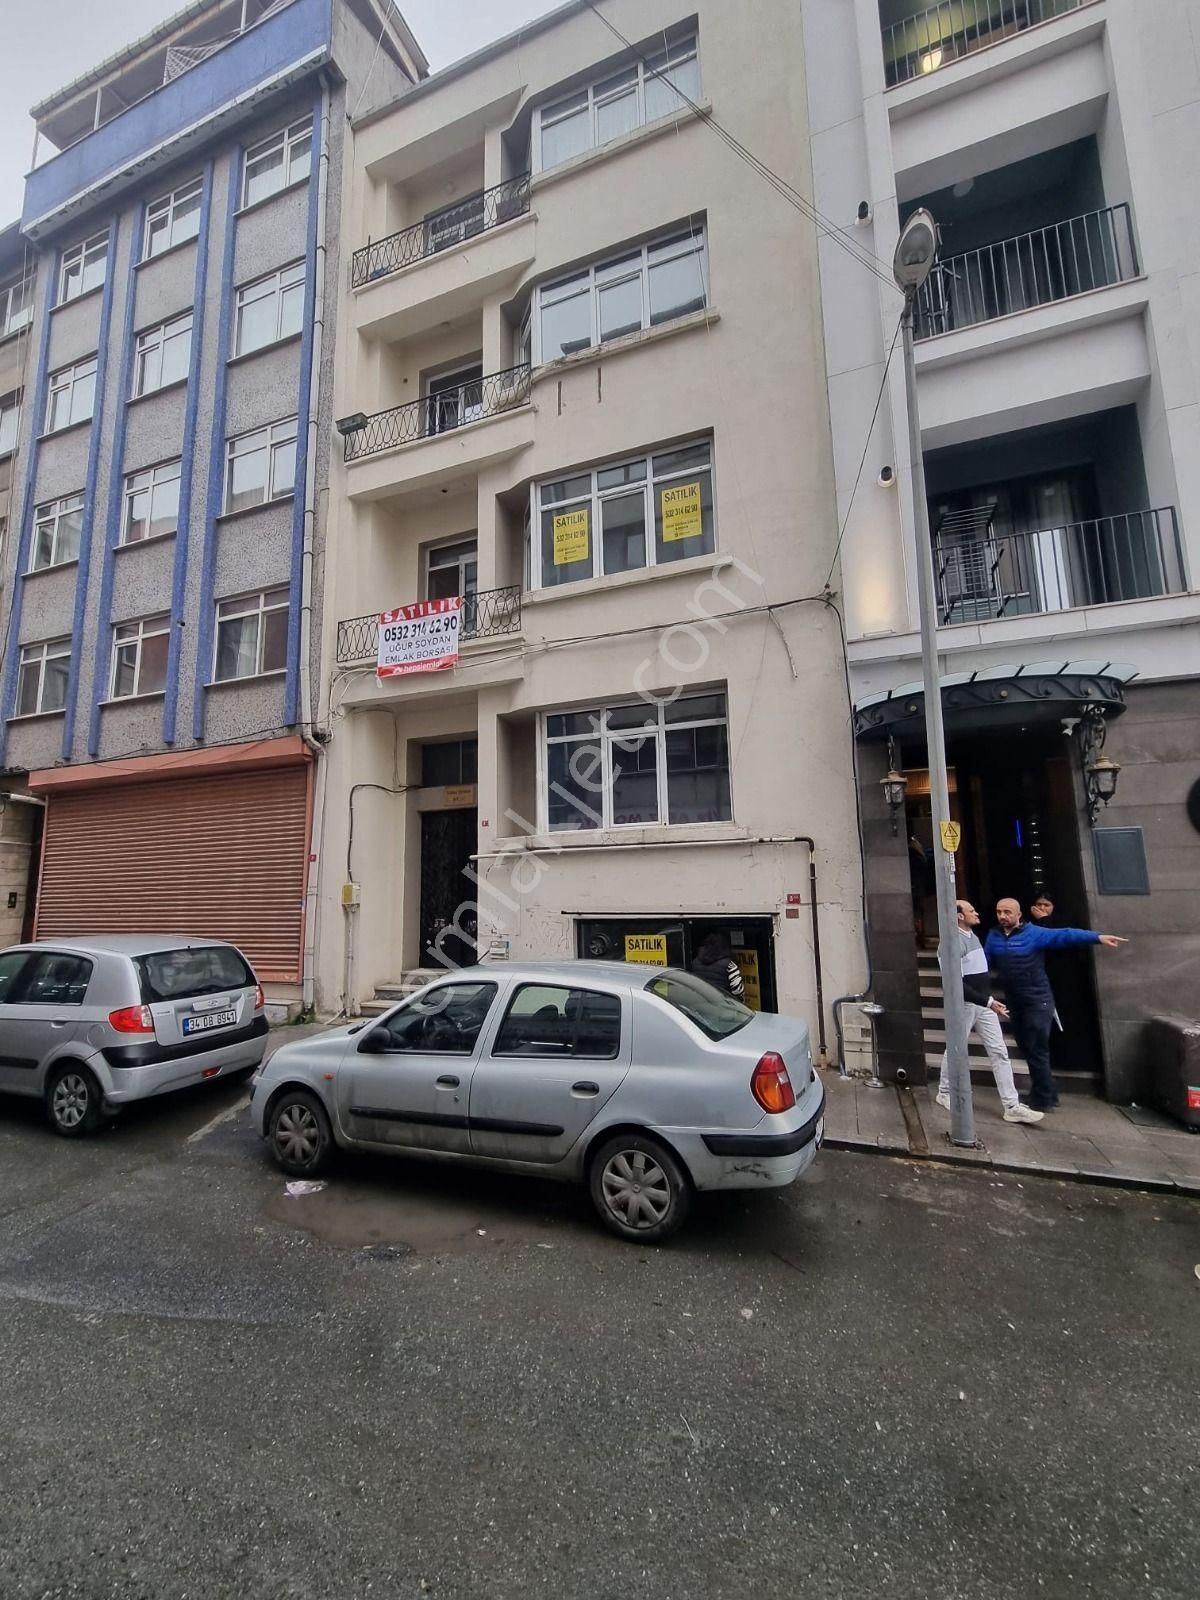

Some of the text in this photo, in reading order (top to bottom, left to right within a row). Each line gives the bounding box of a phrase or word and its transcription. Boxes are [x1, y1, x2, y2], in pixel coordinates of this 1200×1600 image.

[384, 599, 458, 622] SATILIK
[384, 615, 458, 642] 0532 314 62 90
[415, 635, 451, 649] SOYDAN
[385, 646, 454, 664] EMLAK BORSASI
[190, 1020, 200, 1029] 34
[217, 1012, 234, 1024] 8941
